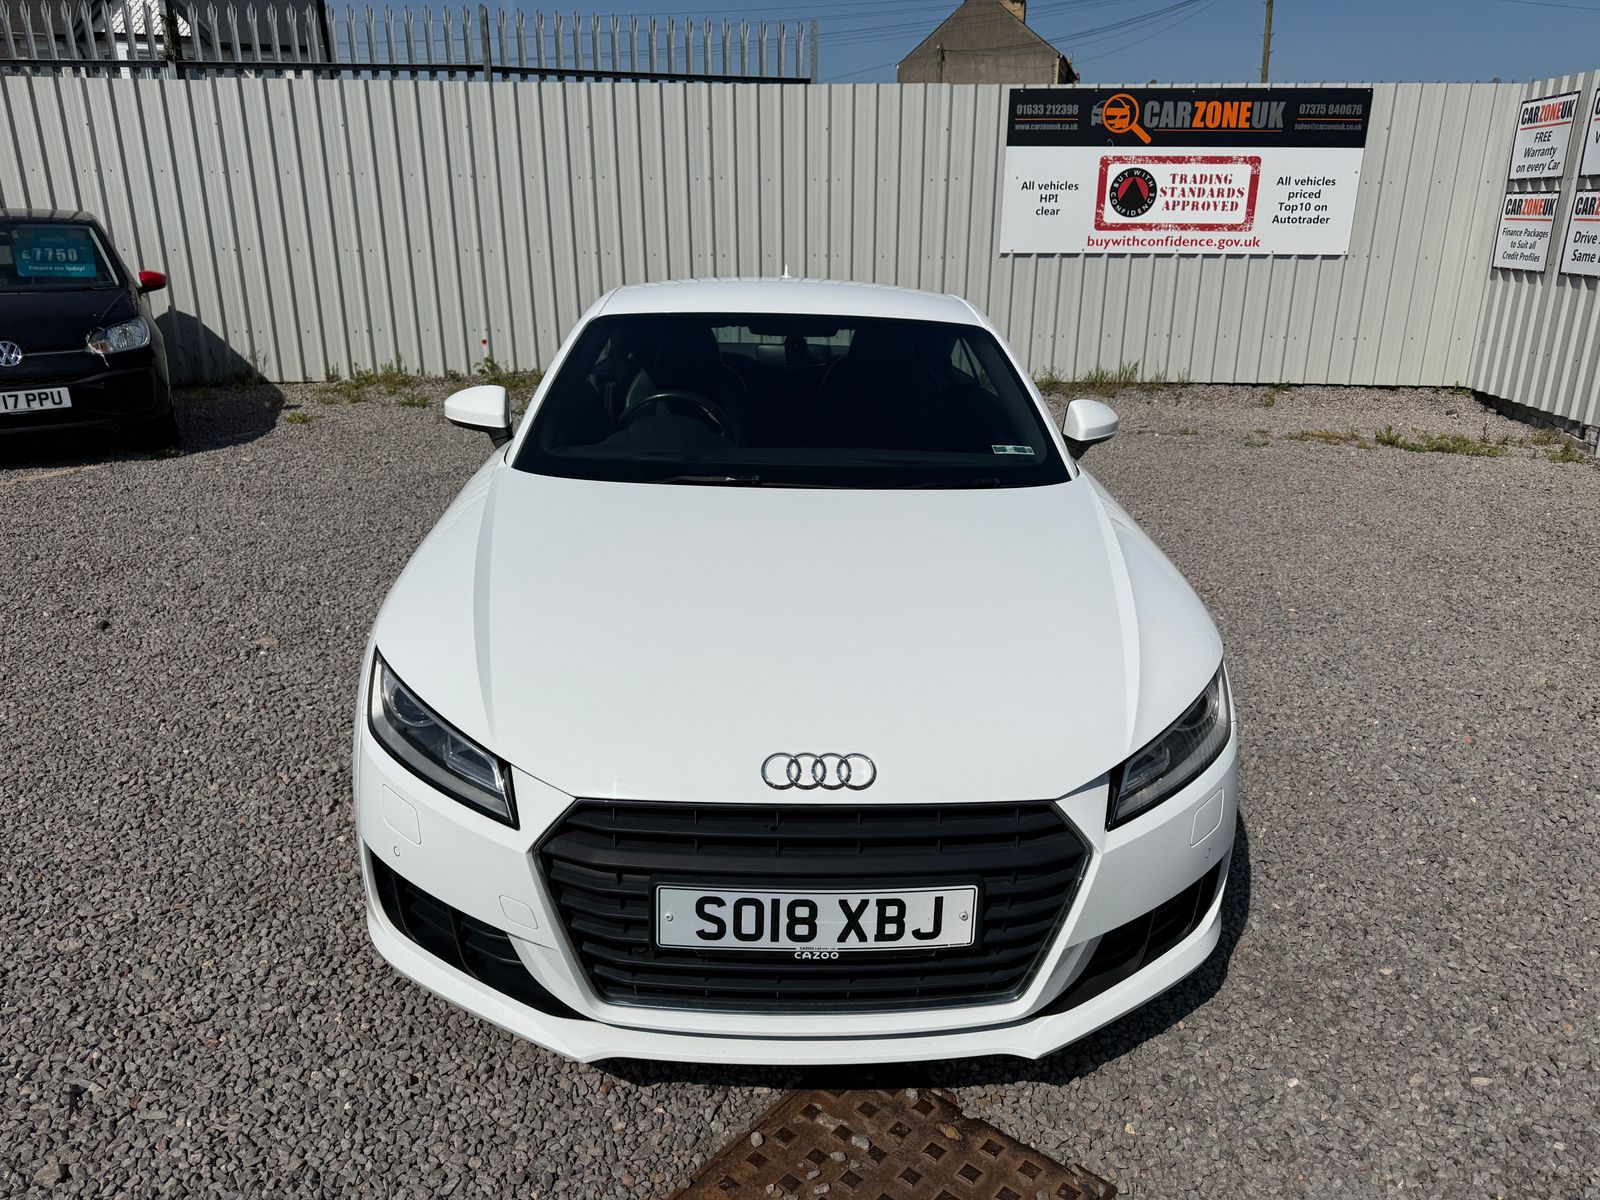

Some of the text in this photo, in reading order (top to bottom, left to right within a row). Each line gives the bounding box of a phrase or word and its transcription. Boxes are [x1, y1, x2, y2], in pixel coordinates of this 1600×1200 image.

[1016, 104, 1079, 115] 01633 212398
[1143, 100, 1287, 128] CARZONEUK
[1299, 103, 1327, 115] 07375
[1534, 130, 1553, 143] FREE
[1524, 146, 1558, 159] Warranty
[1516, 159, 1561, 174] on every Car
[1113, 169, 1154, 189] BUY WITH
[1170, 173, 1233, 185] TRADING
[1276, 176, 1337, 186] All vehicles
[1021, 180, 1080, 191] All vehicles
[1039, 193, 1059, 203] HPI
[1159, 186, 1245, 199] STANDARDS
[1287, 189, 1322, 201] priced
[1035, 205, 1061, 215] clear
[1110, 192, 1155, 216] CONFIDENCE
[1161, 200, 1239, 212] APPROVED
[1314, 204, 1328, 212] on
[1271, 214, 1331, 224] Autotrader
[1502, 227, 1549, 240] Finance Packages
[1573, 230, 1598, 244] Drive
[1087, 235, 1261, 250] buywithconfidence.gov.uk
[1510, 240, 1537, 250] to Suit all
[1502, 251, 1541, 263] Credit Profiles
[1571, 249, 1596, 263] Same
[2, 390, 63, 410] 17 PPU
[695, 895, 944, 943] SO18 XBJ
[794, 951, 839, 960] CAZOO
